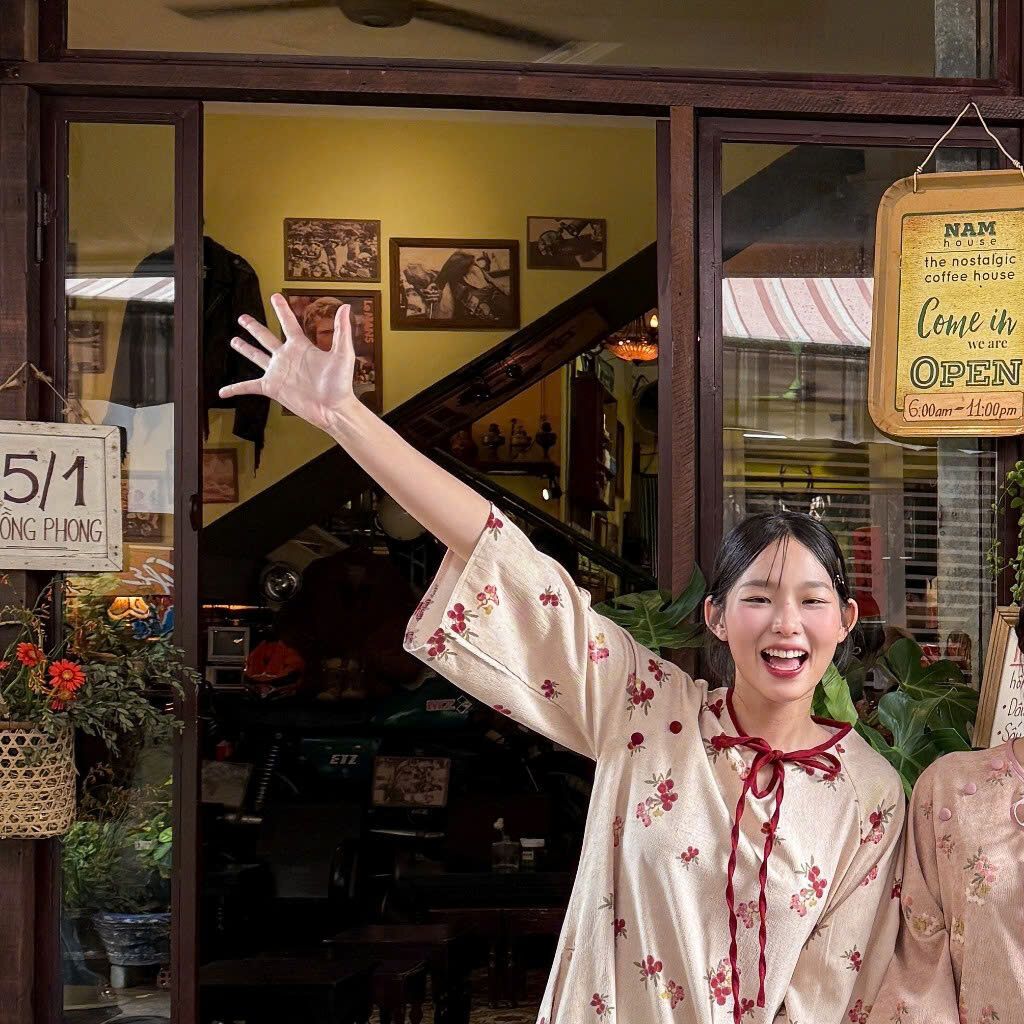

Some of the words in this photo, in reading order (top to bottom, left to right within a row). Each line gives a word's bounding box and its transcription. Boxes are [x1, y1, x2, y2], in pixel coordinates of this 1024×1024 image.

[944, 221, 996, 238] NAM
[944, 238, 997, 248] house
[925, 256, 947, 268] the
[952, 253, 1016, 268] nostalgic
[925, 271, 968, 283] coffee
[973, 270, 1015, 281] house
[917, 296, 984, 339] Come
[990, 308, 1018, 336] in
[968, 340, 985, 350] we
[987, 339, 1008, 349] are
[910, 355, 1023, 389] OPEN
[44, 517, 102, 543] PHONG
[330, 754, 359, 765] ETZ
